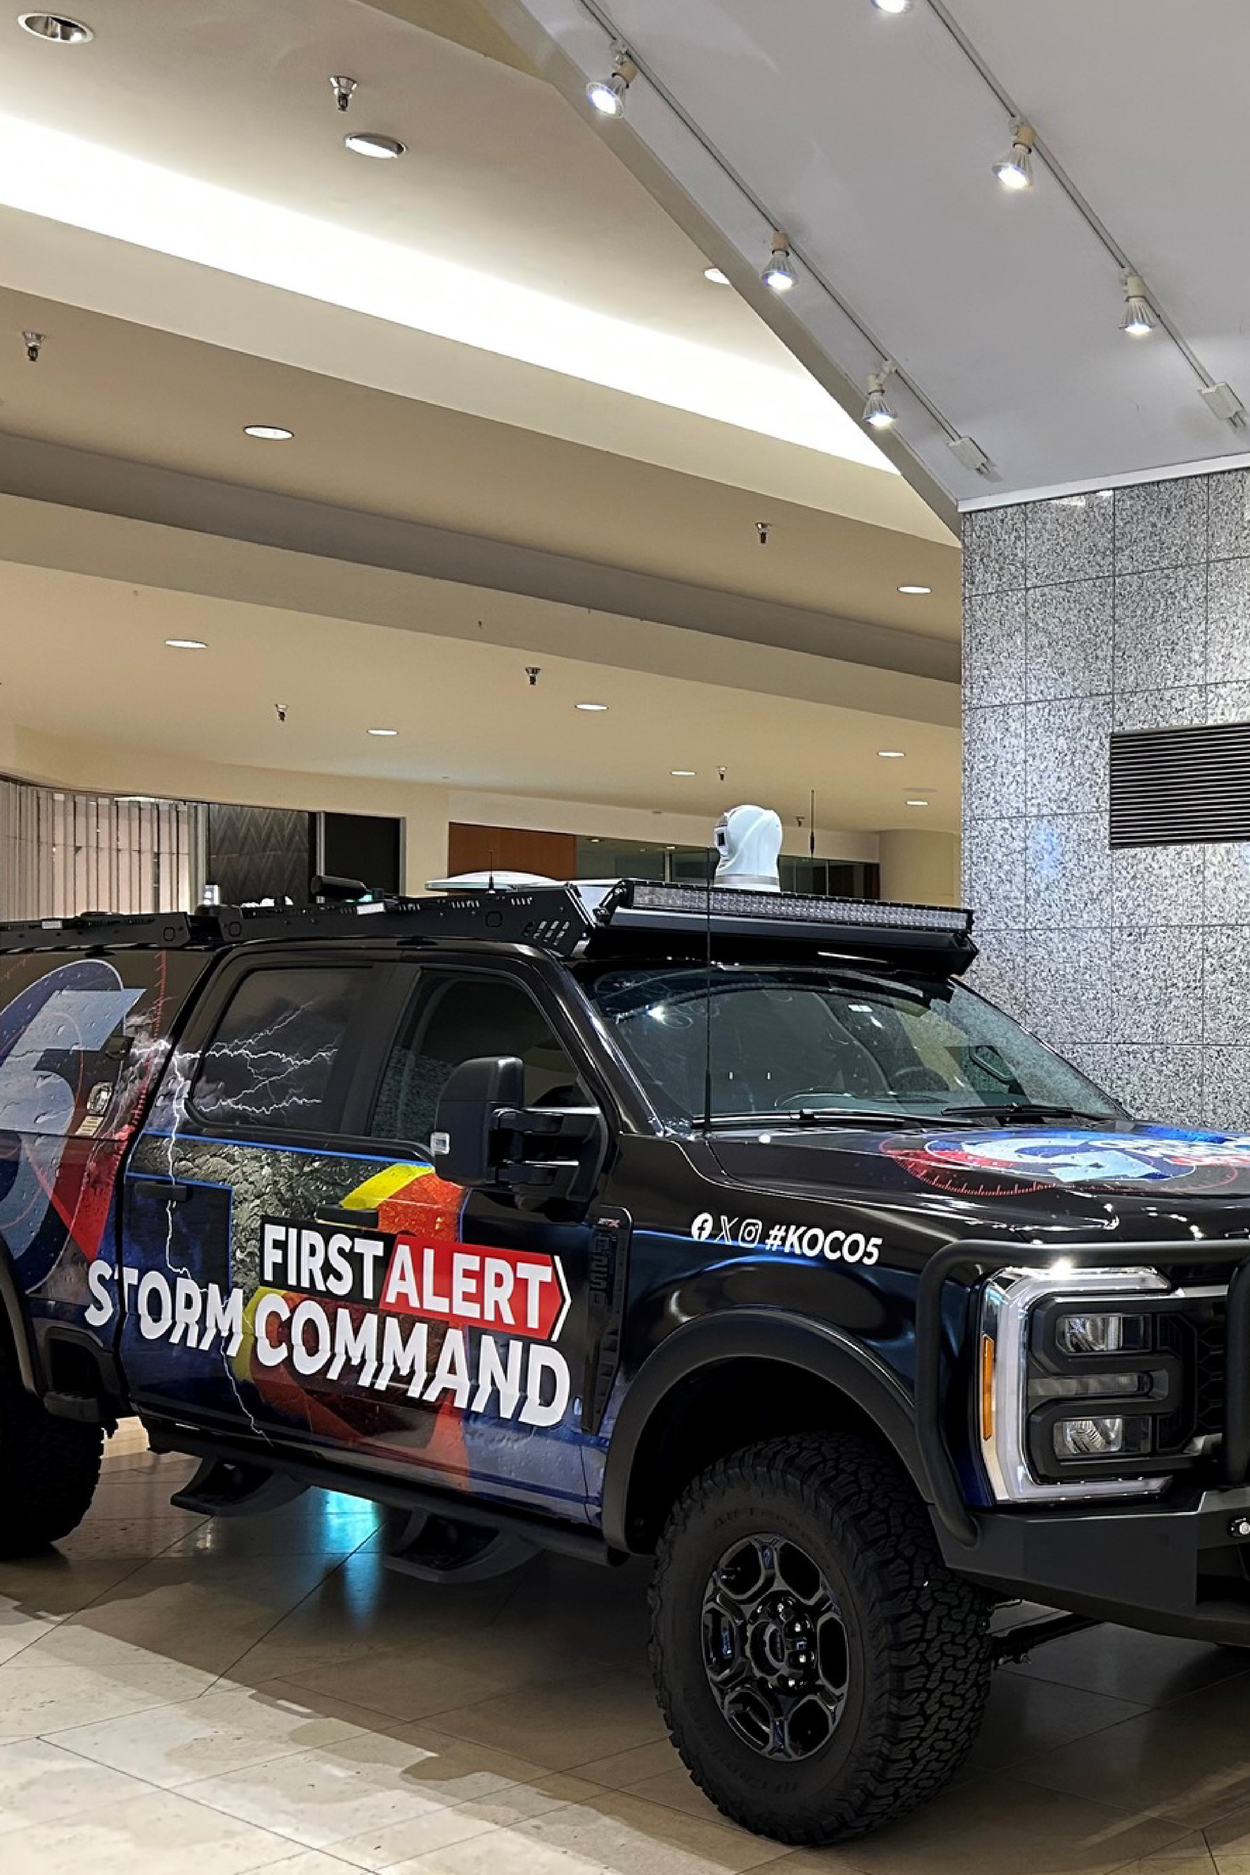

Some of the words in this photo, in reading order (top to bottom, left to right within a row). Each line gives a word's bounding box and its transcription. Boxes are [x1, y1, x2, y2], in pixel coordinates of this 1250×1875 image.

[262, 1222, 384, 1298] FIRST
[380, 1244, 553, 1331] ALERT
[765, 1224, 883, 1265] #KOCO5
[84, 1259, 245, 1356] STORM
[254, 1293, 571, 1427] COMMAND
